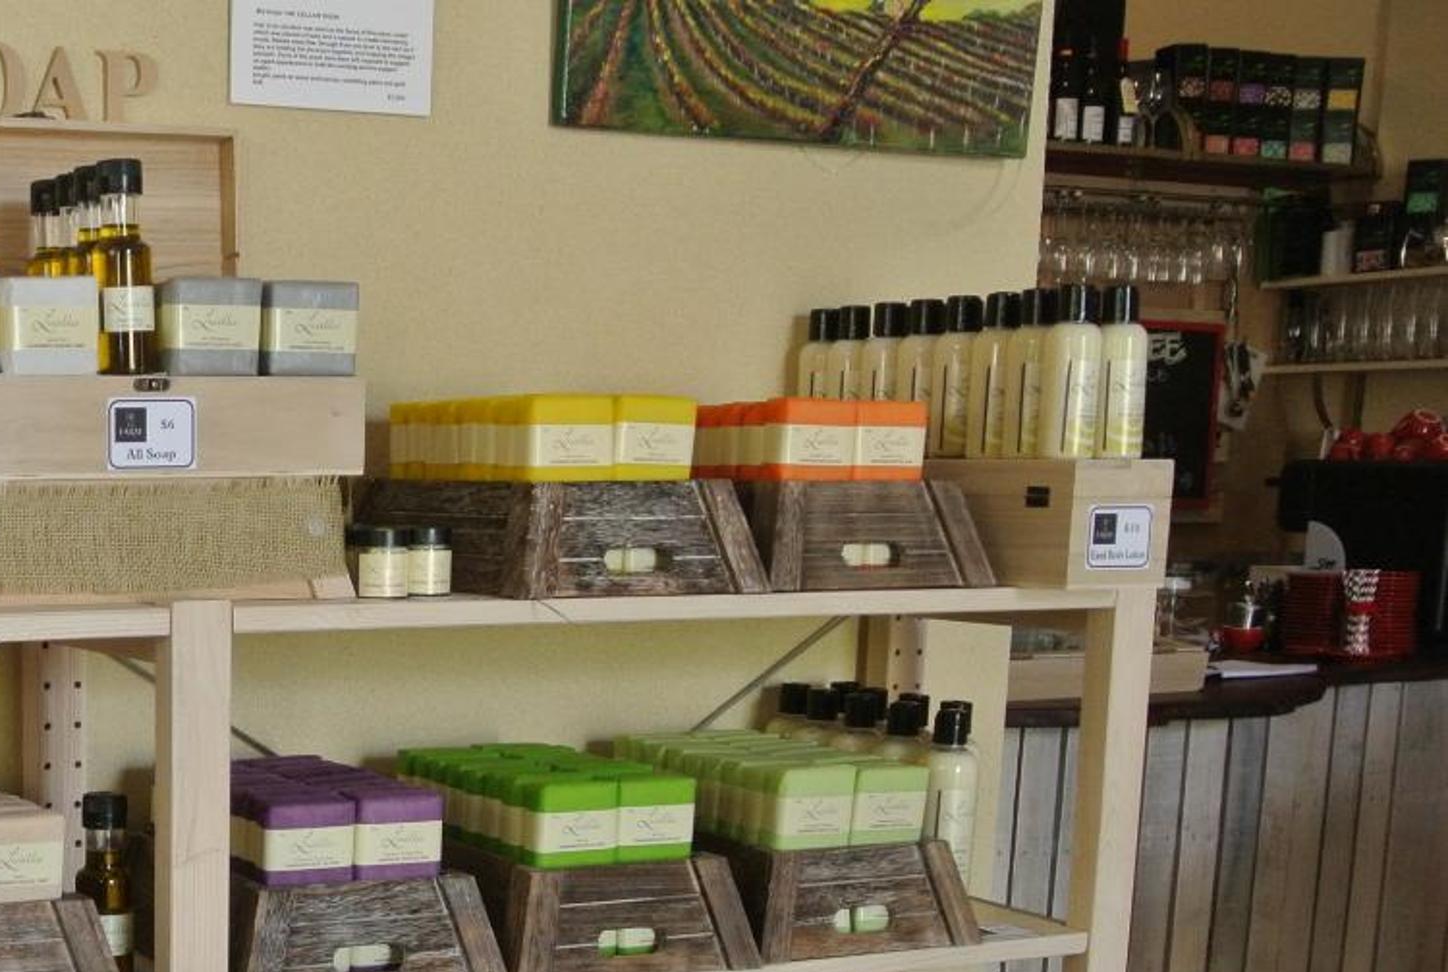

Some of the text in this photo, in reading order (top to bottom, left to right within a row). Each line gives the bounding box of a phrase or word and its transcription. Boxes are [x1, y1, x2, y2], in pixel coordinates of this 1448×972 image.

[160, 418, 175, 430] $6
[127, 448, 177, 462] All Soap
